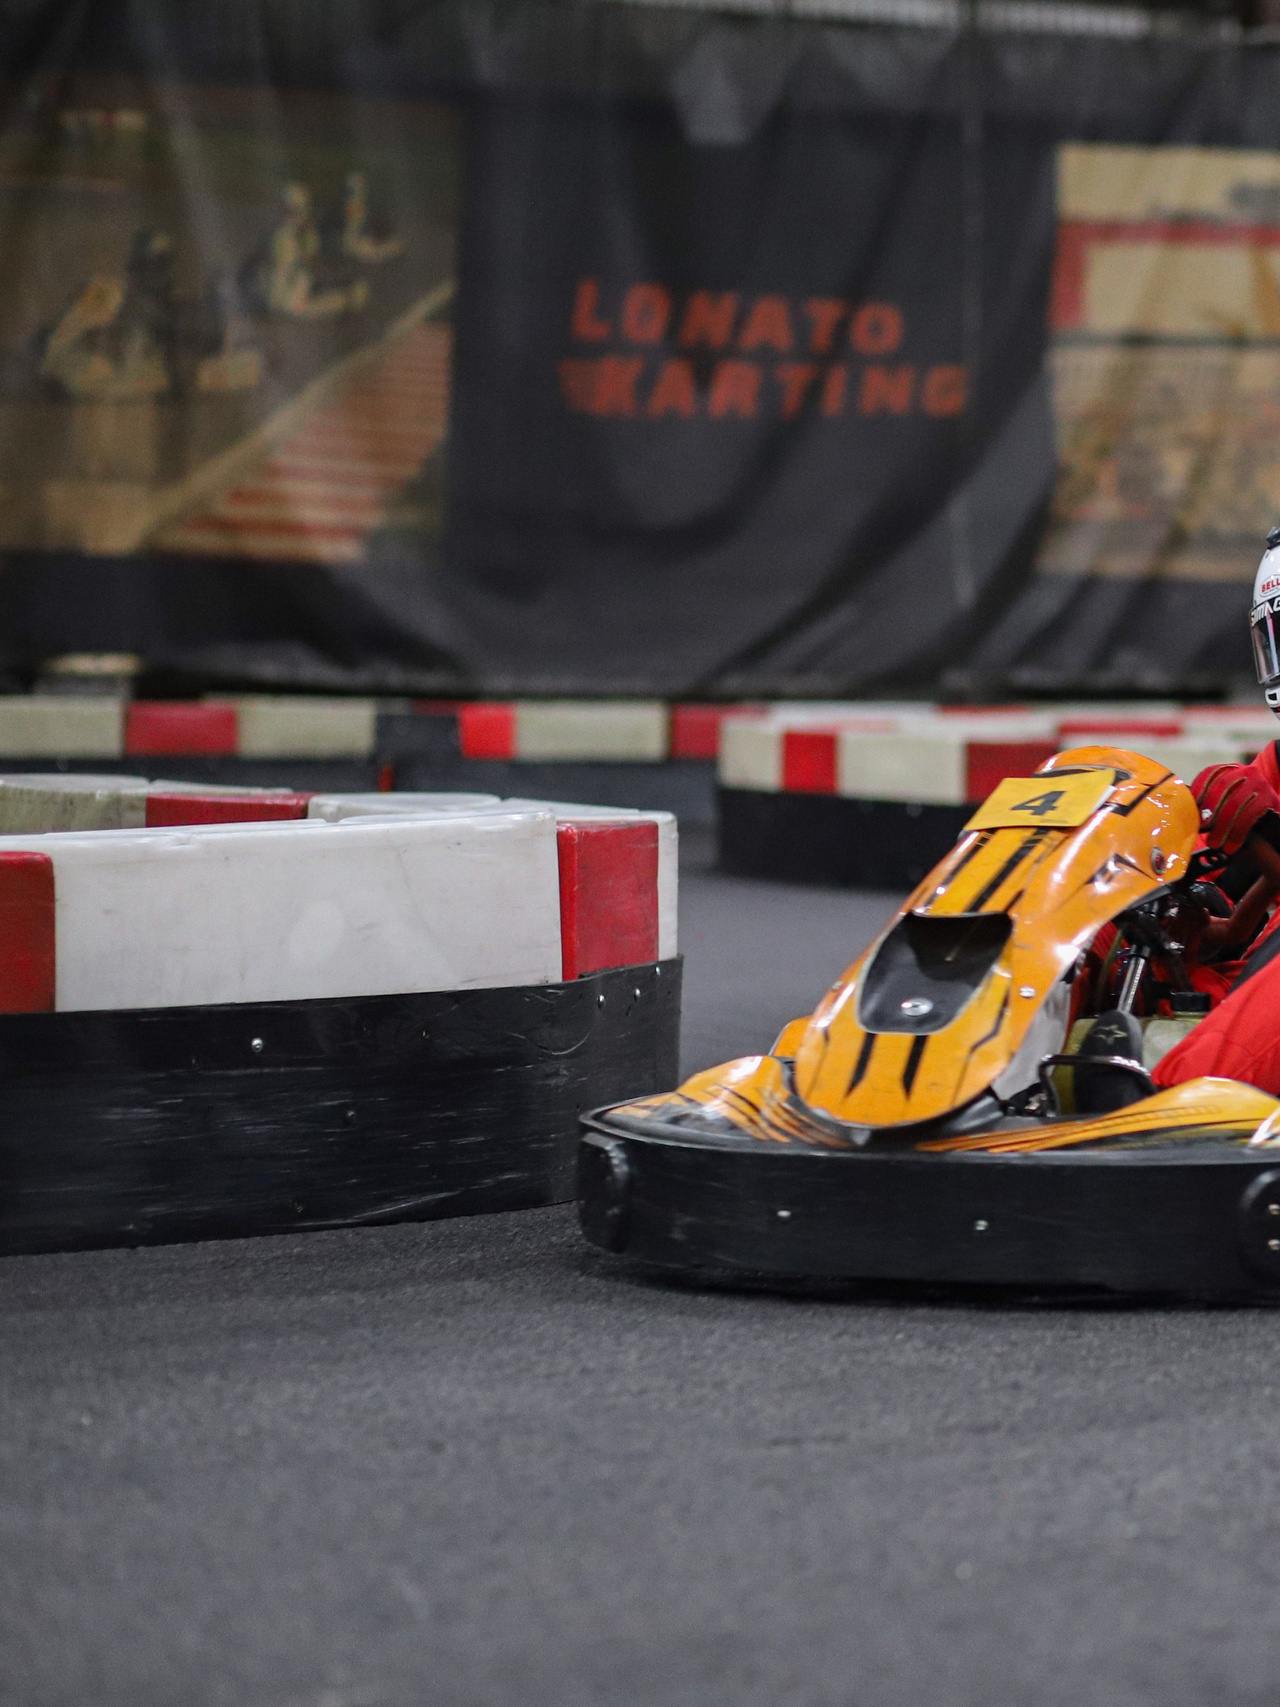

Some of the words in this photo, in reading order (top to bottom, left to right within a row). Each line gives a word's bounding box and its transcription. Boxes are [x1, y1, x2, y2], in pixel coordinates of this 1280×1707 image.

[571, 276, 903, 355] LONATO
[590, 356, 968, 421] KARTING
[1010, 790, 1067, 815] 4
